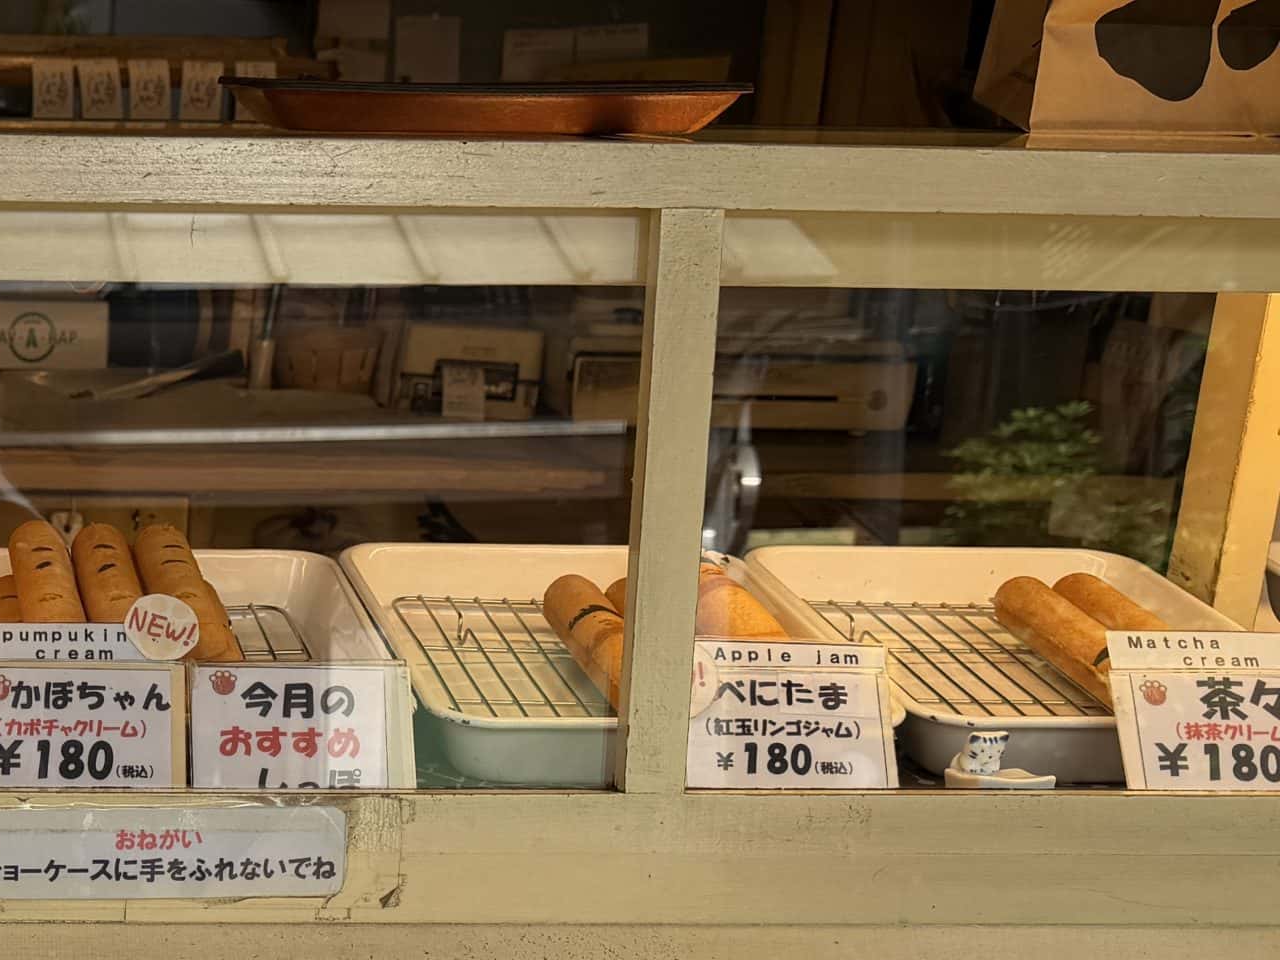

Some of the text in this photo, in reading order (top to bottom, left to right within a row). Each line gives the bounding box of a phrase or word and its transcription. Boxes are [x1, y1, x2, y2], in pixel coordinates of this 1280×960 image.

[2, 628, 127, 643] pumpukin
[128, 607, 197, 646] NEW!
[1128, 636, 1220, 650] Matcha
[35, 648, 113, 660] cream
[714, 647, 859, 665] Apple jam
[1183, 656, 1259, 668] cream
[10, 680, 171, 711] かぼちゃん
[240, 681, 355, 718] 今月の
[219, 726, 360, 759] おすすめ
[115, 829, 203, 850] おねがい
